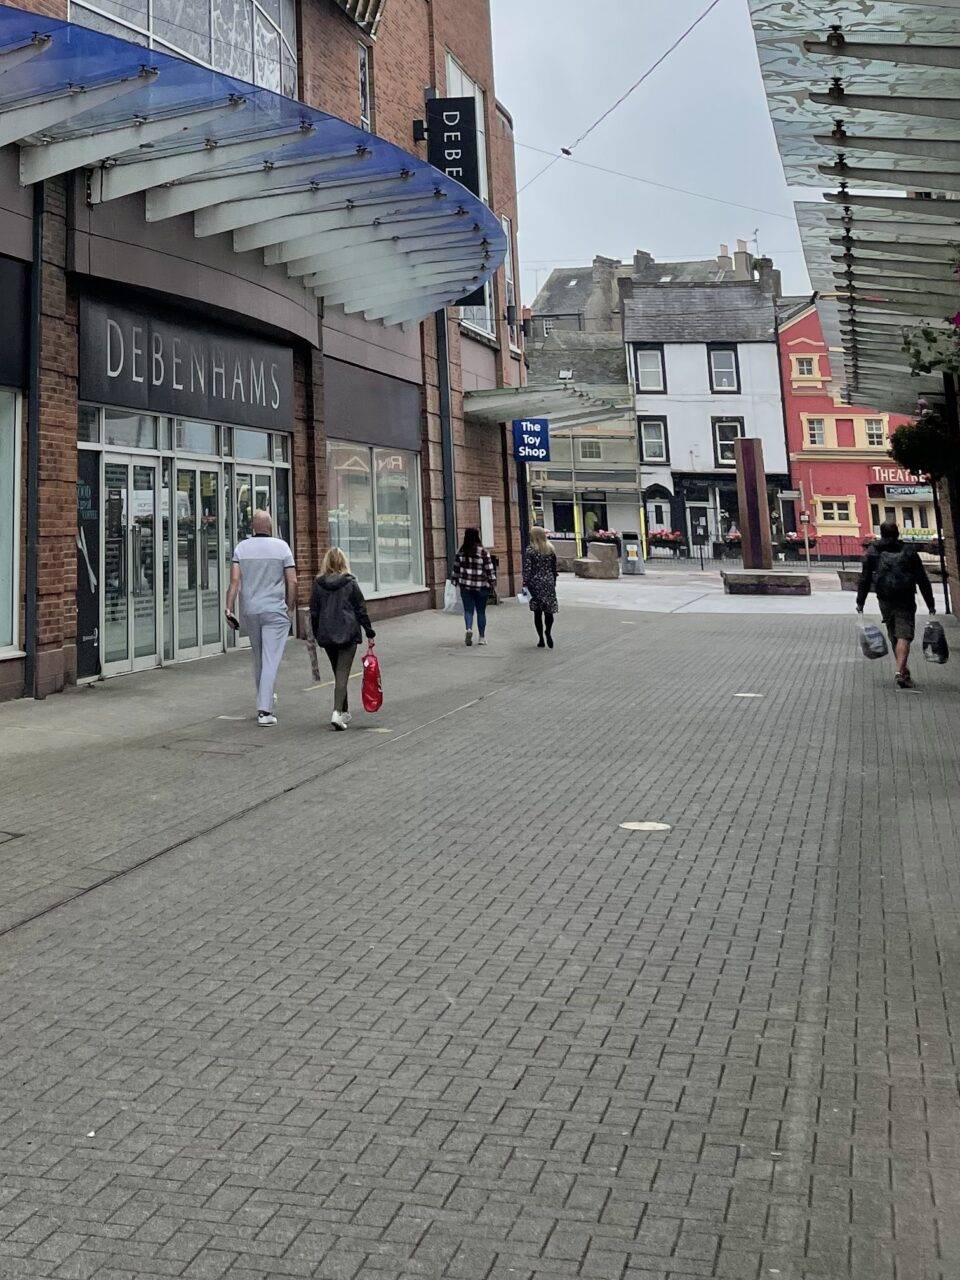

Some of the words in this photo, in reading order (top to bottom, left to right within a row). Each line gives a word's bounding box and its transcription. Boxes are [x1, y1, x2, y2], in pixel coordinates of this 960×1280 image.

[107, 318, 280, 410] DEBENHAMS
[521, 422, 541, 432] The
[523, 434, 541, 446] Toy
[518, 446, 547, 458] Shop
